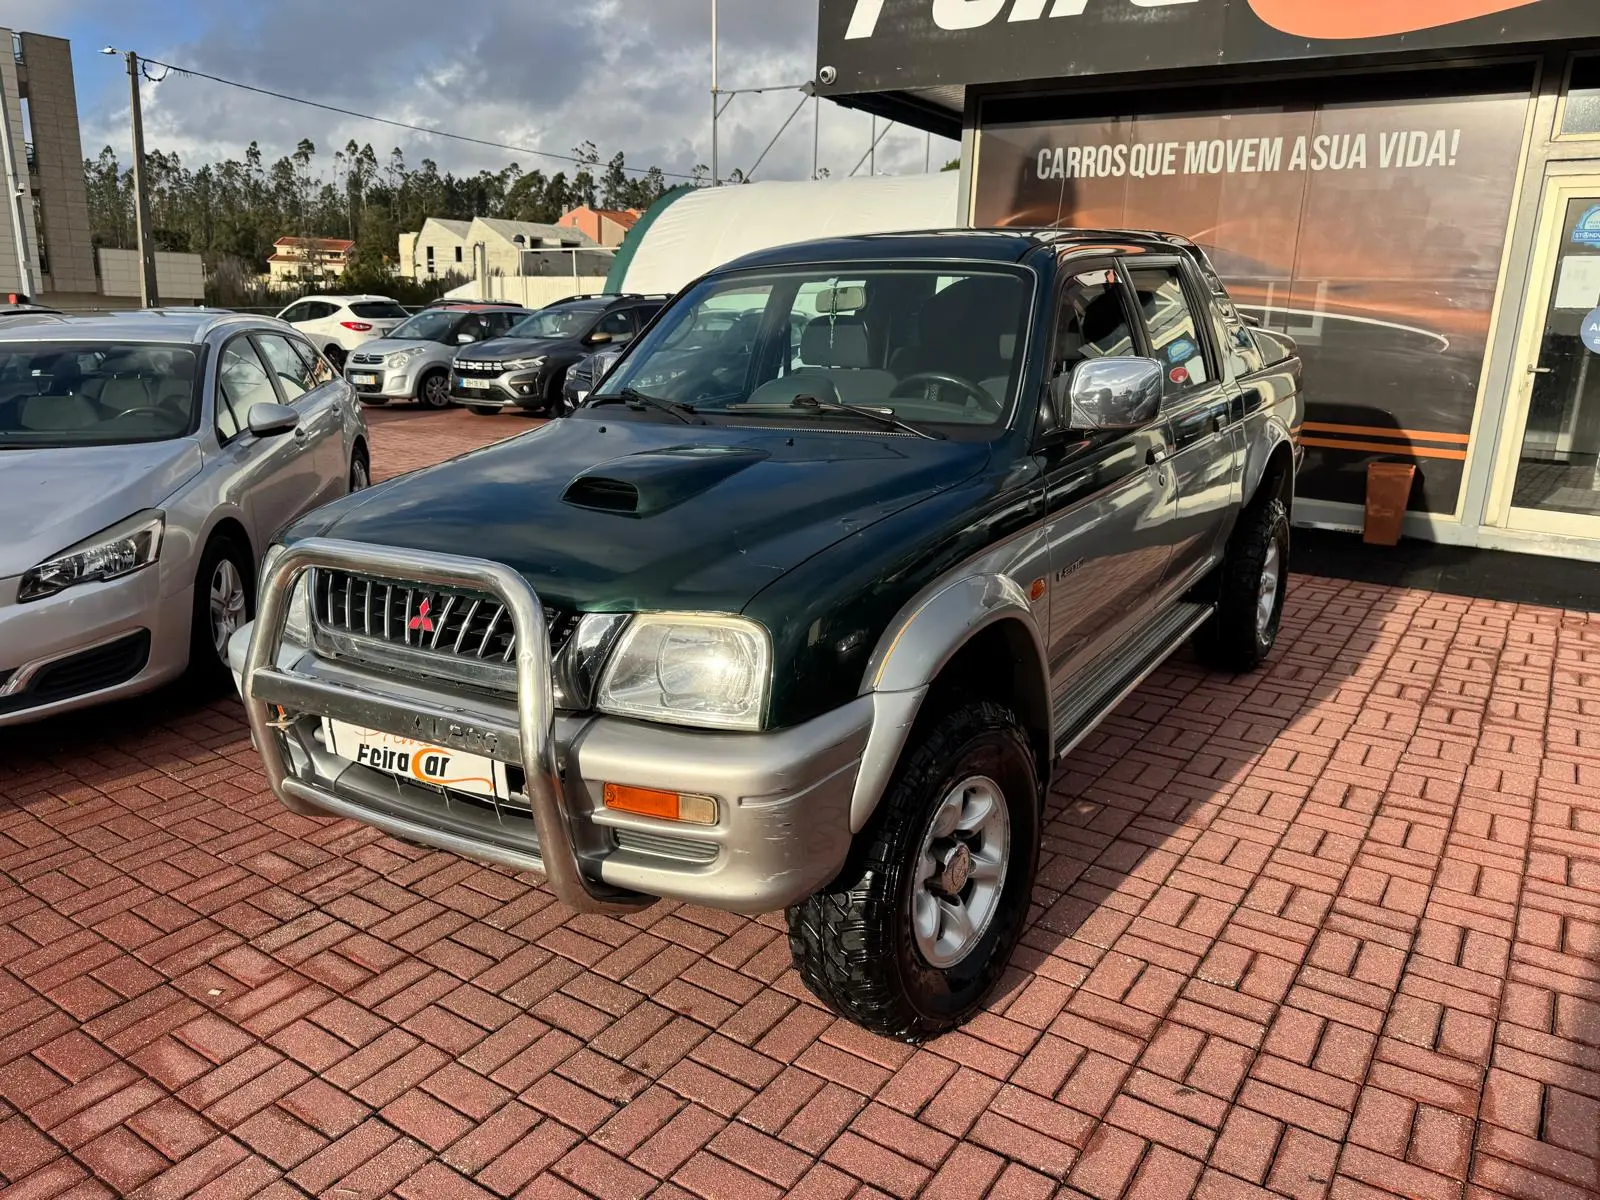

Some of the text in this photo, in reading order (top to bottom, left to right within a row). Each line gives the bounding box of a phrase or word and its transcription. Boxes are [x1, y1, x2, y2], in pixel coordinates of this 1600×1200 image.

[1036, 129, 1461, 180] CARROS QUE MOVEM A SUA VIDA!
